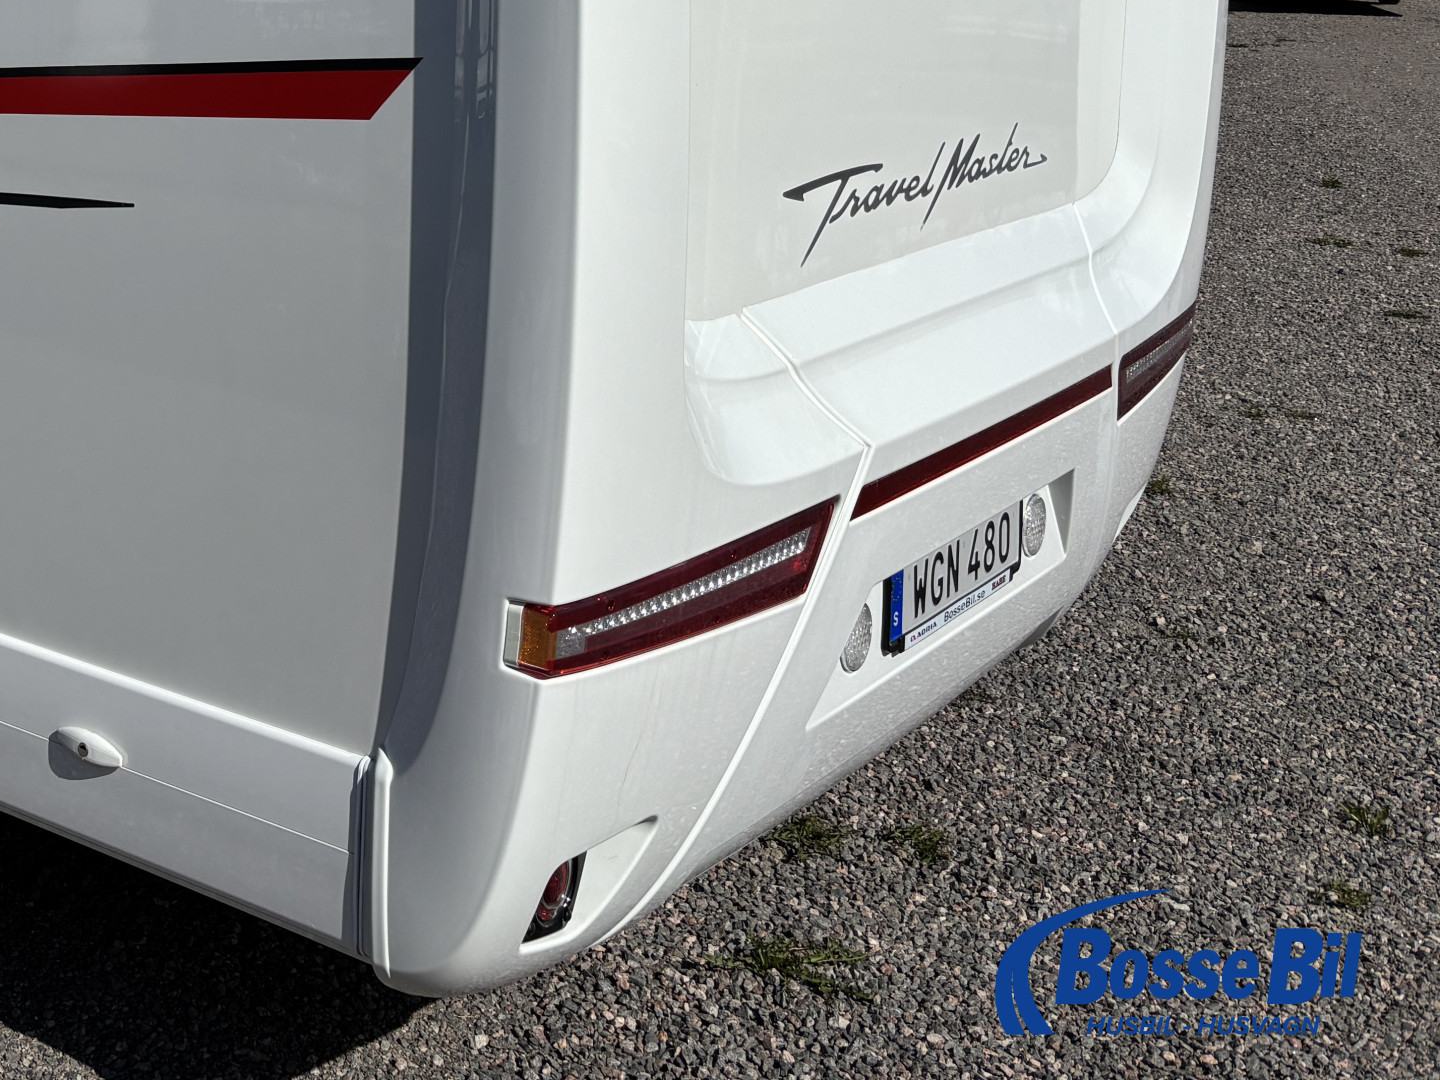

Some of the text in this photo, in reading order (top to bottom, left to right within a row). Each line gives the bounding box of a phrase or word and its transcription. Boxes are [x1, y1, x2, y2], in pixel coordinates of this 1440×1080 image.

[913, 511, 1010, 618] WGN 480
[893, 610, 899, 627] S
[916, 621, 938, 639] ADRIA
[943, 590, 986, 623] BosseBil.se
